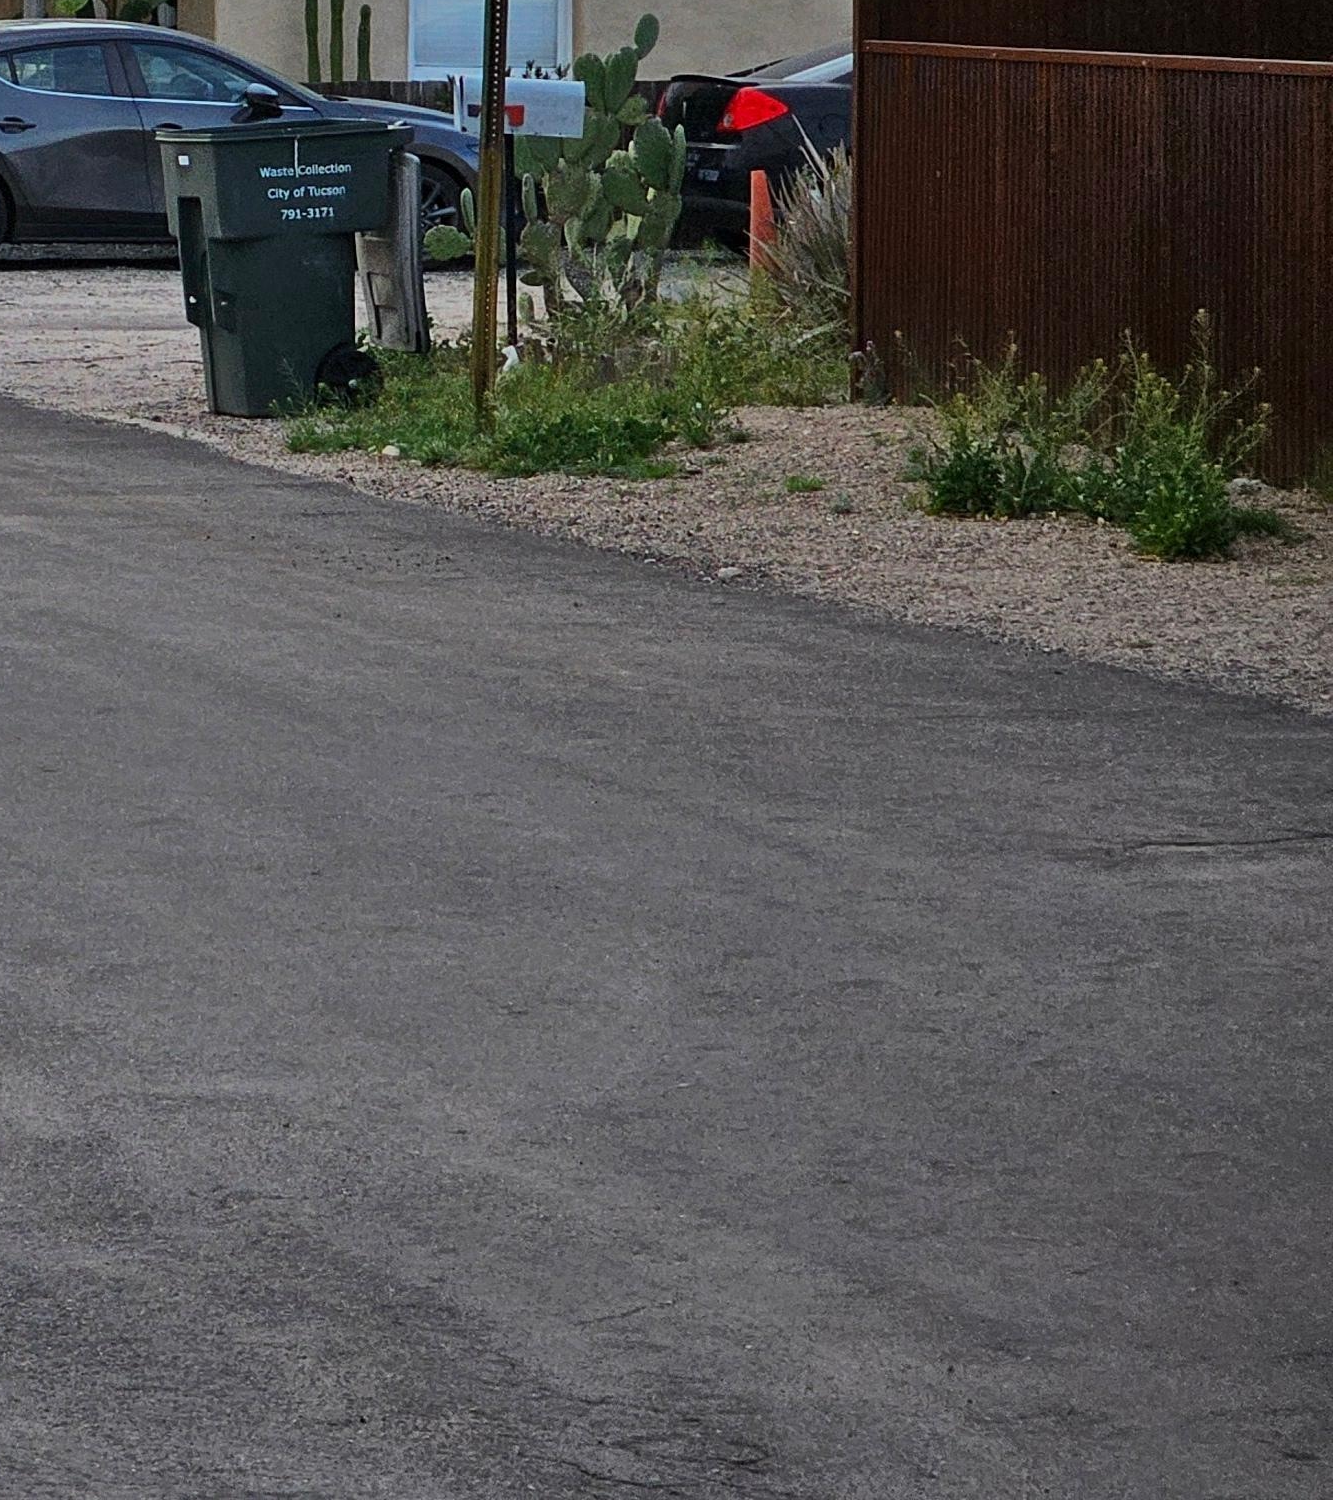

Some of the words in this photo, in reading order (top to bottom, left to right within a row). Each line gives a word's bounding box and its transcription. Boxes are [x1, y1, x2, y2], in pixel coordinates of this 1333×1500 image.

[259, 167, 294, 178] Waste
[298, 163, 352, 175] Collection
[267, 188, 290, 200] City
[293, 186, 306, 198] of
[307, 186, 346, 197] Tucson
[280, 206, 335, 220] 791-3171
